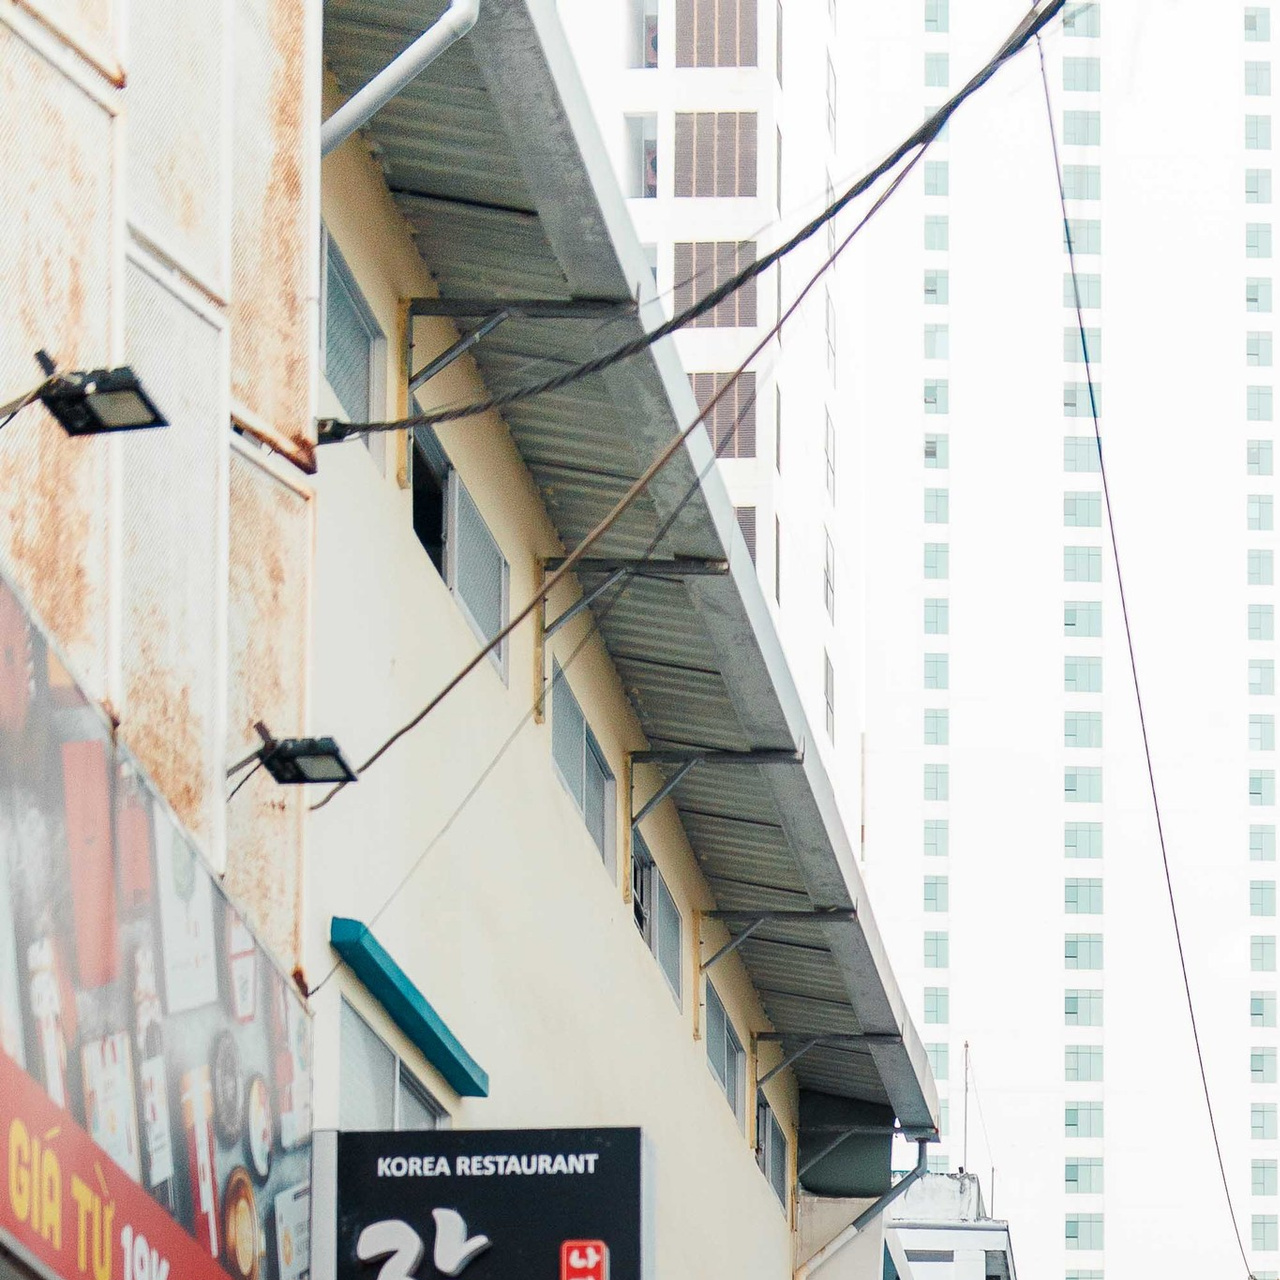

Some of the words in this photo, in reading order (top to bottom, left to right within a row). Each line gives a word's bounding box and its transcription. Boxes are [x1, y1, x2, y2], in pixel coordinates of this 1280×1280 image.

[9, 1118, 62, 1250] GIÁ
[377, 1156, 451, 1177] KOREA
[456, 1153, 599, 1175] RESTAURANT
